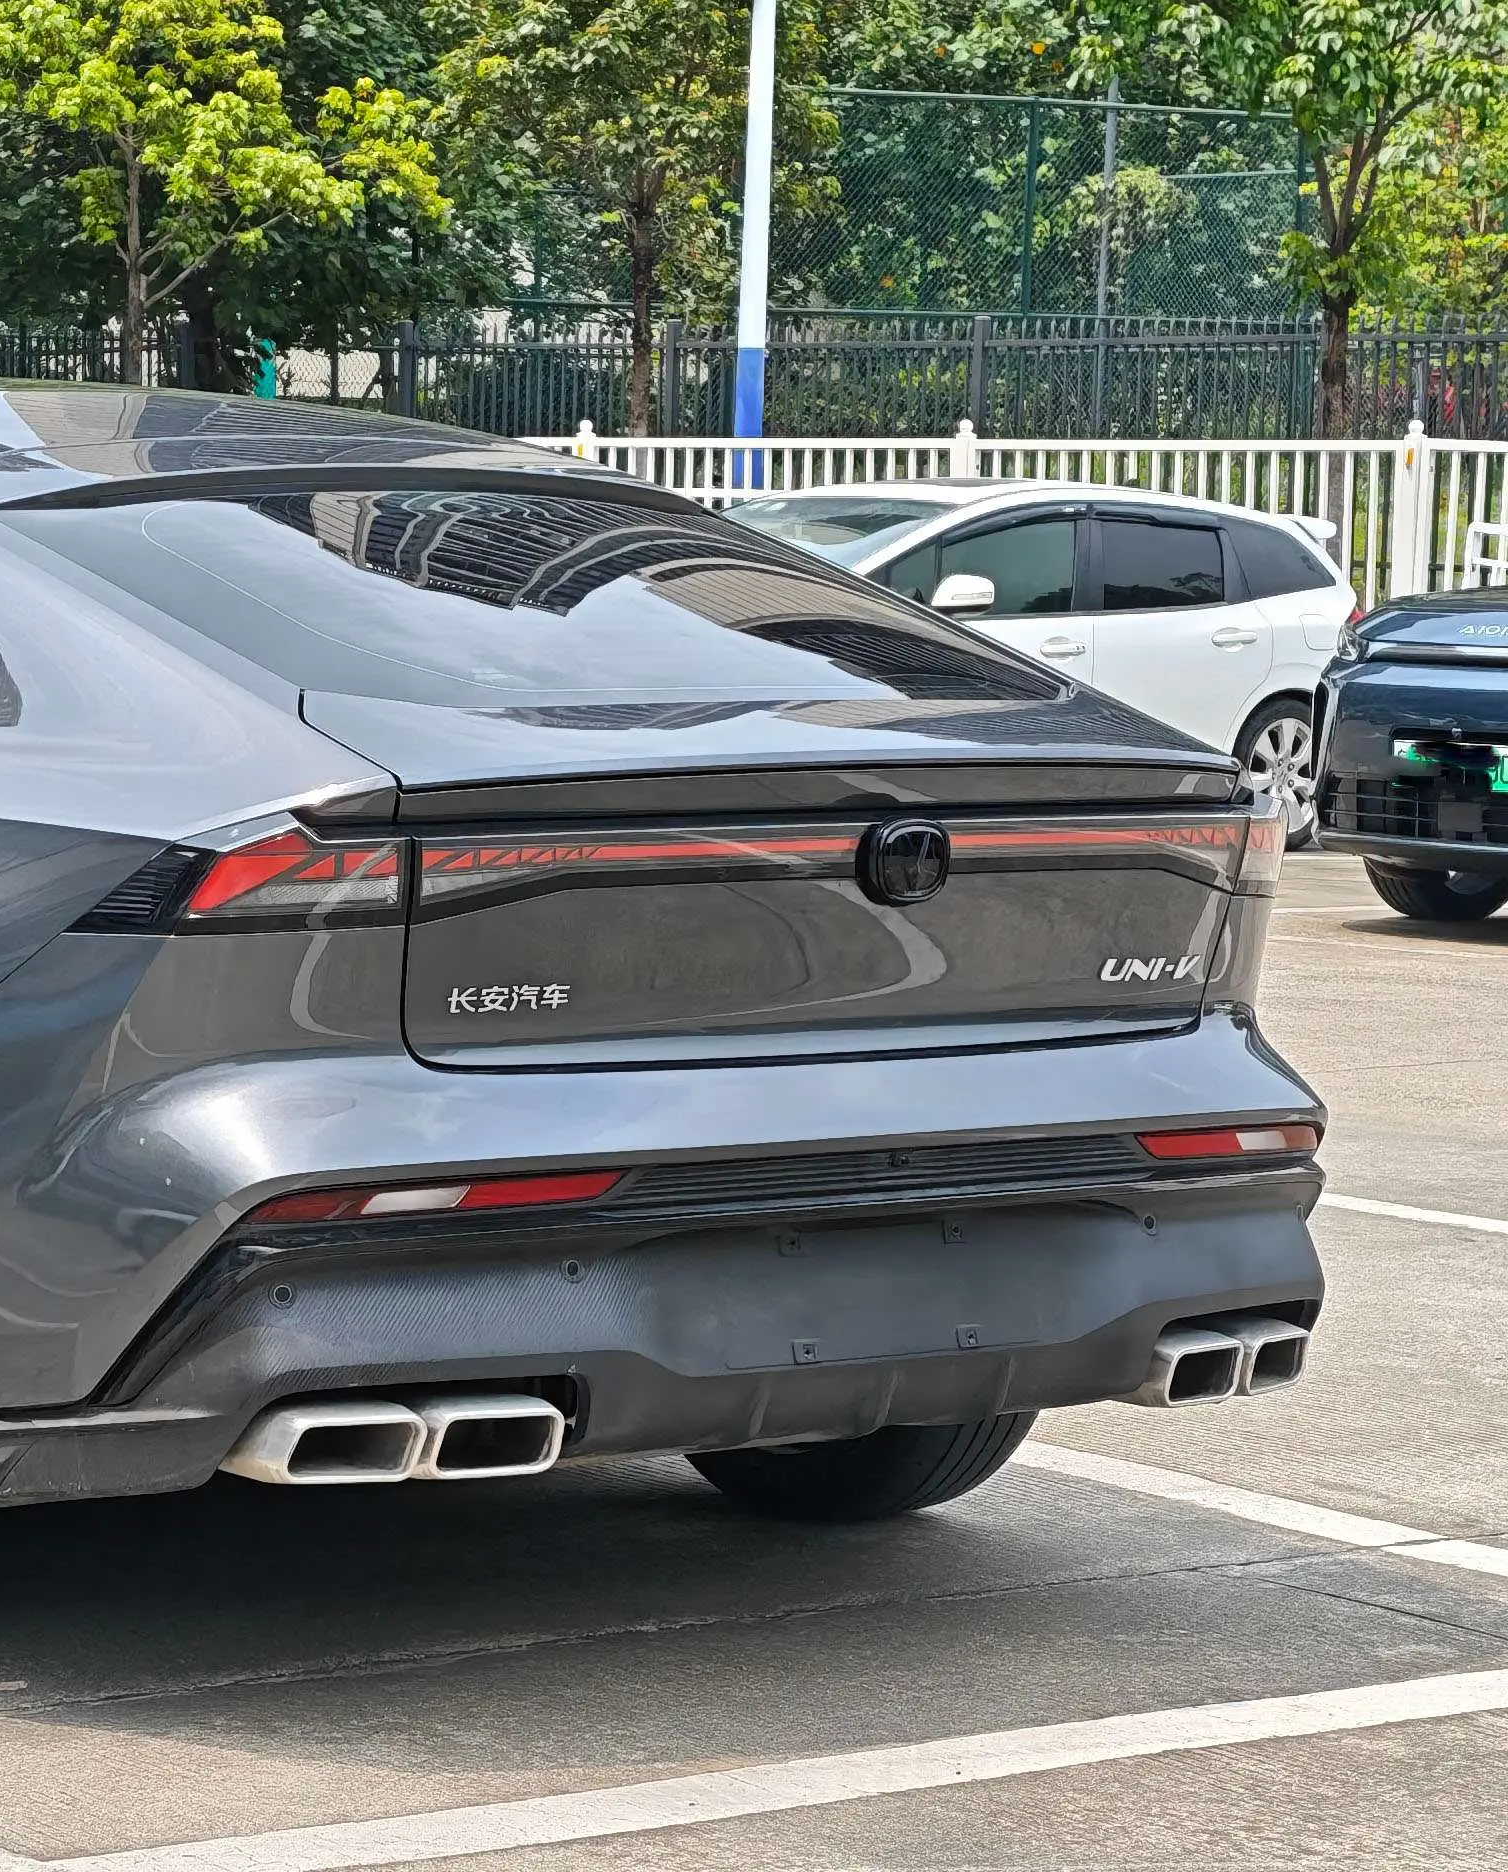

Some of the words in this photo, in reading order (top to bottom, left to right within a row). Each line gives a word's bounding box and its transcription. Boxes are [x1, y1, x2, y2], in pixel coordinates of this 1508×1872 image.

[1100, 955, 1201, 982] UNI-V
[448, 983, 571, 1014] 长安汽车
